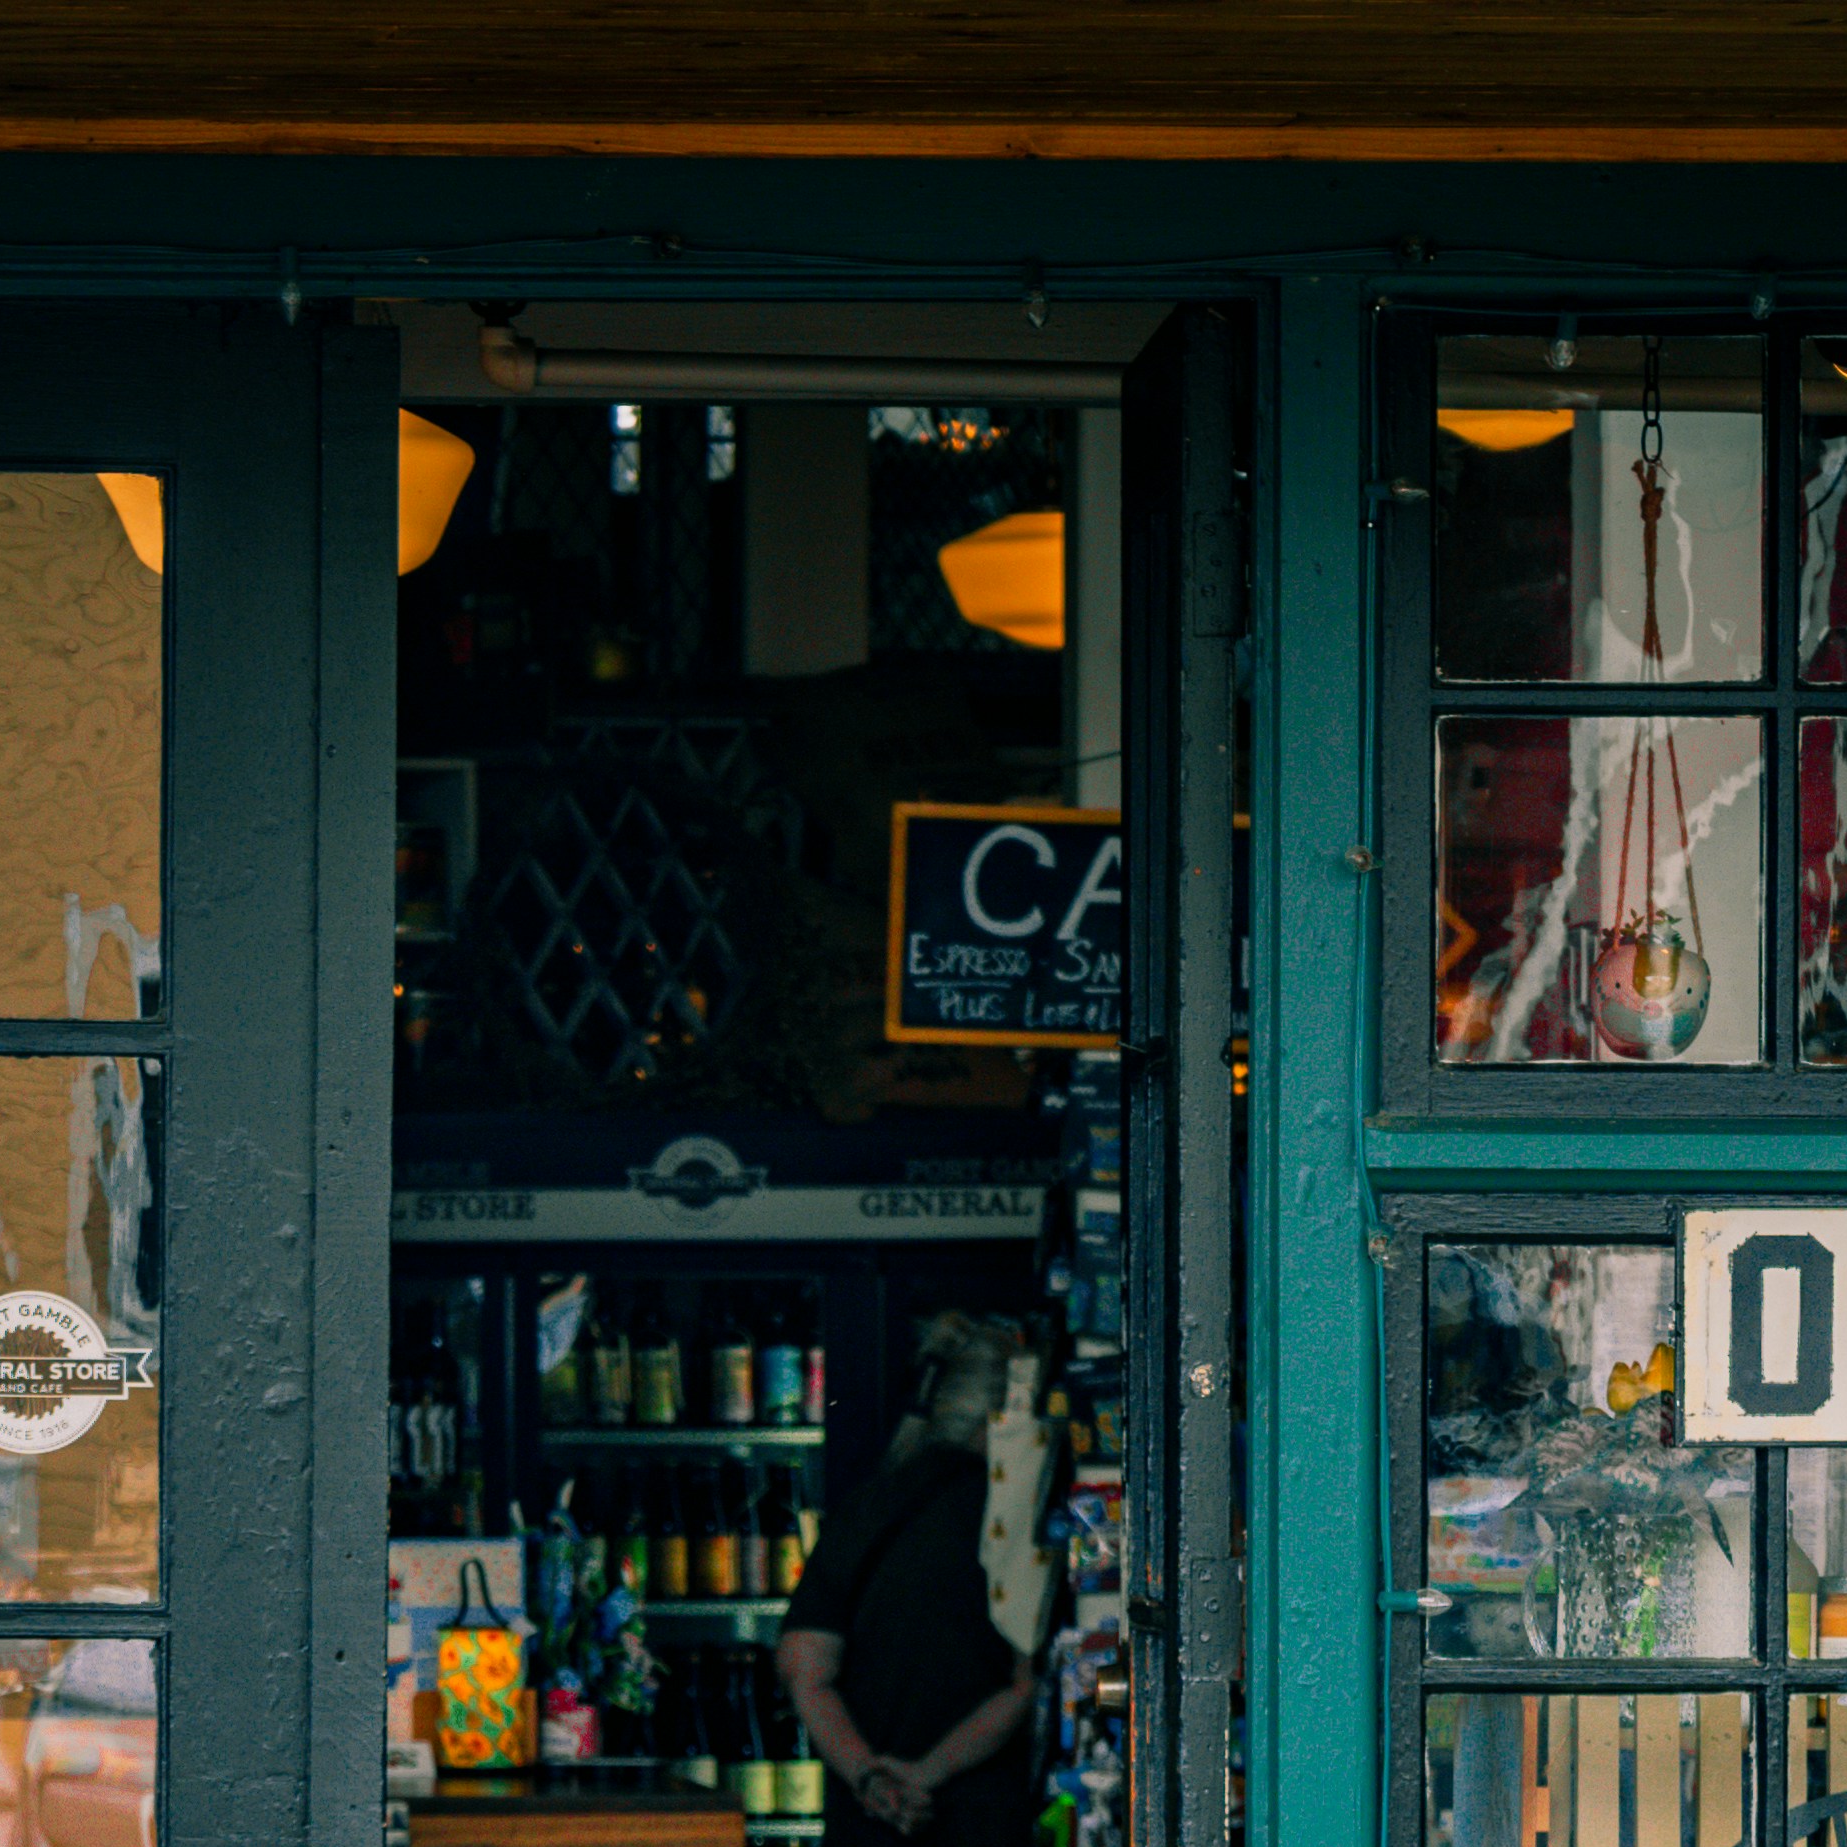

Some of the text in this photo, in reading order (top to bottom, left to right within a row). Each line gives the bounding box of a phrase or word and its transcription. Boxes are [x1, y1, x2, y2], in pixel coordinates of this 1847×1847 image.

[859, 1191, 1034, 1219] GENERAL
[19, 1304, 92, 1348] GAMBLE
[49, 1363, 121, 1380] STORE
[30, 1384, 63, 1393] CAFE
